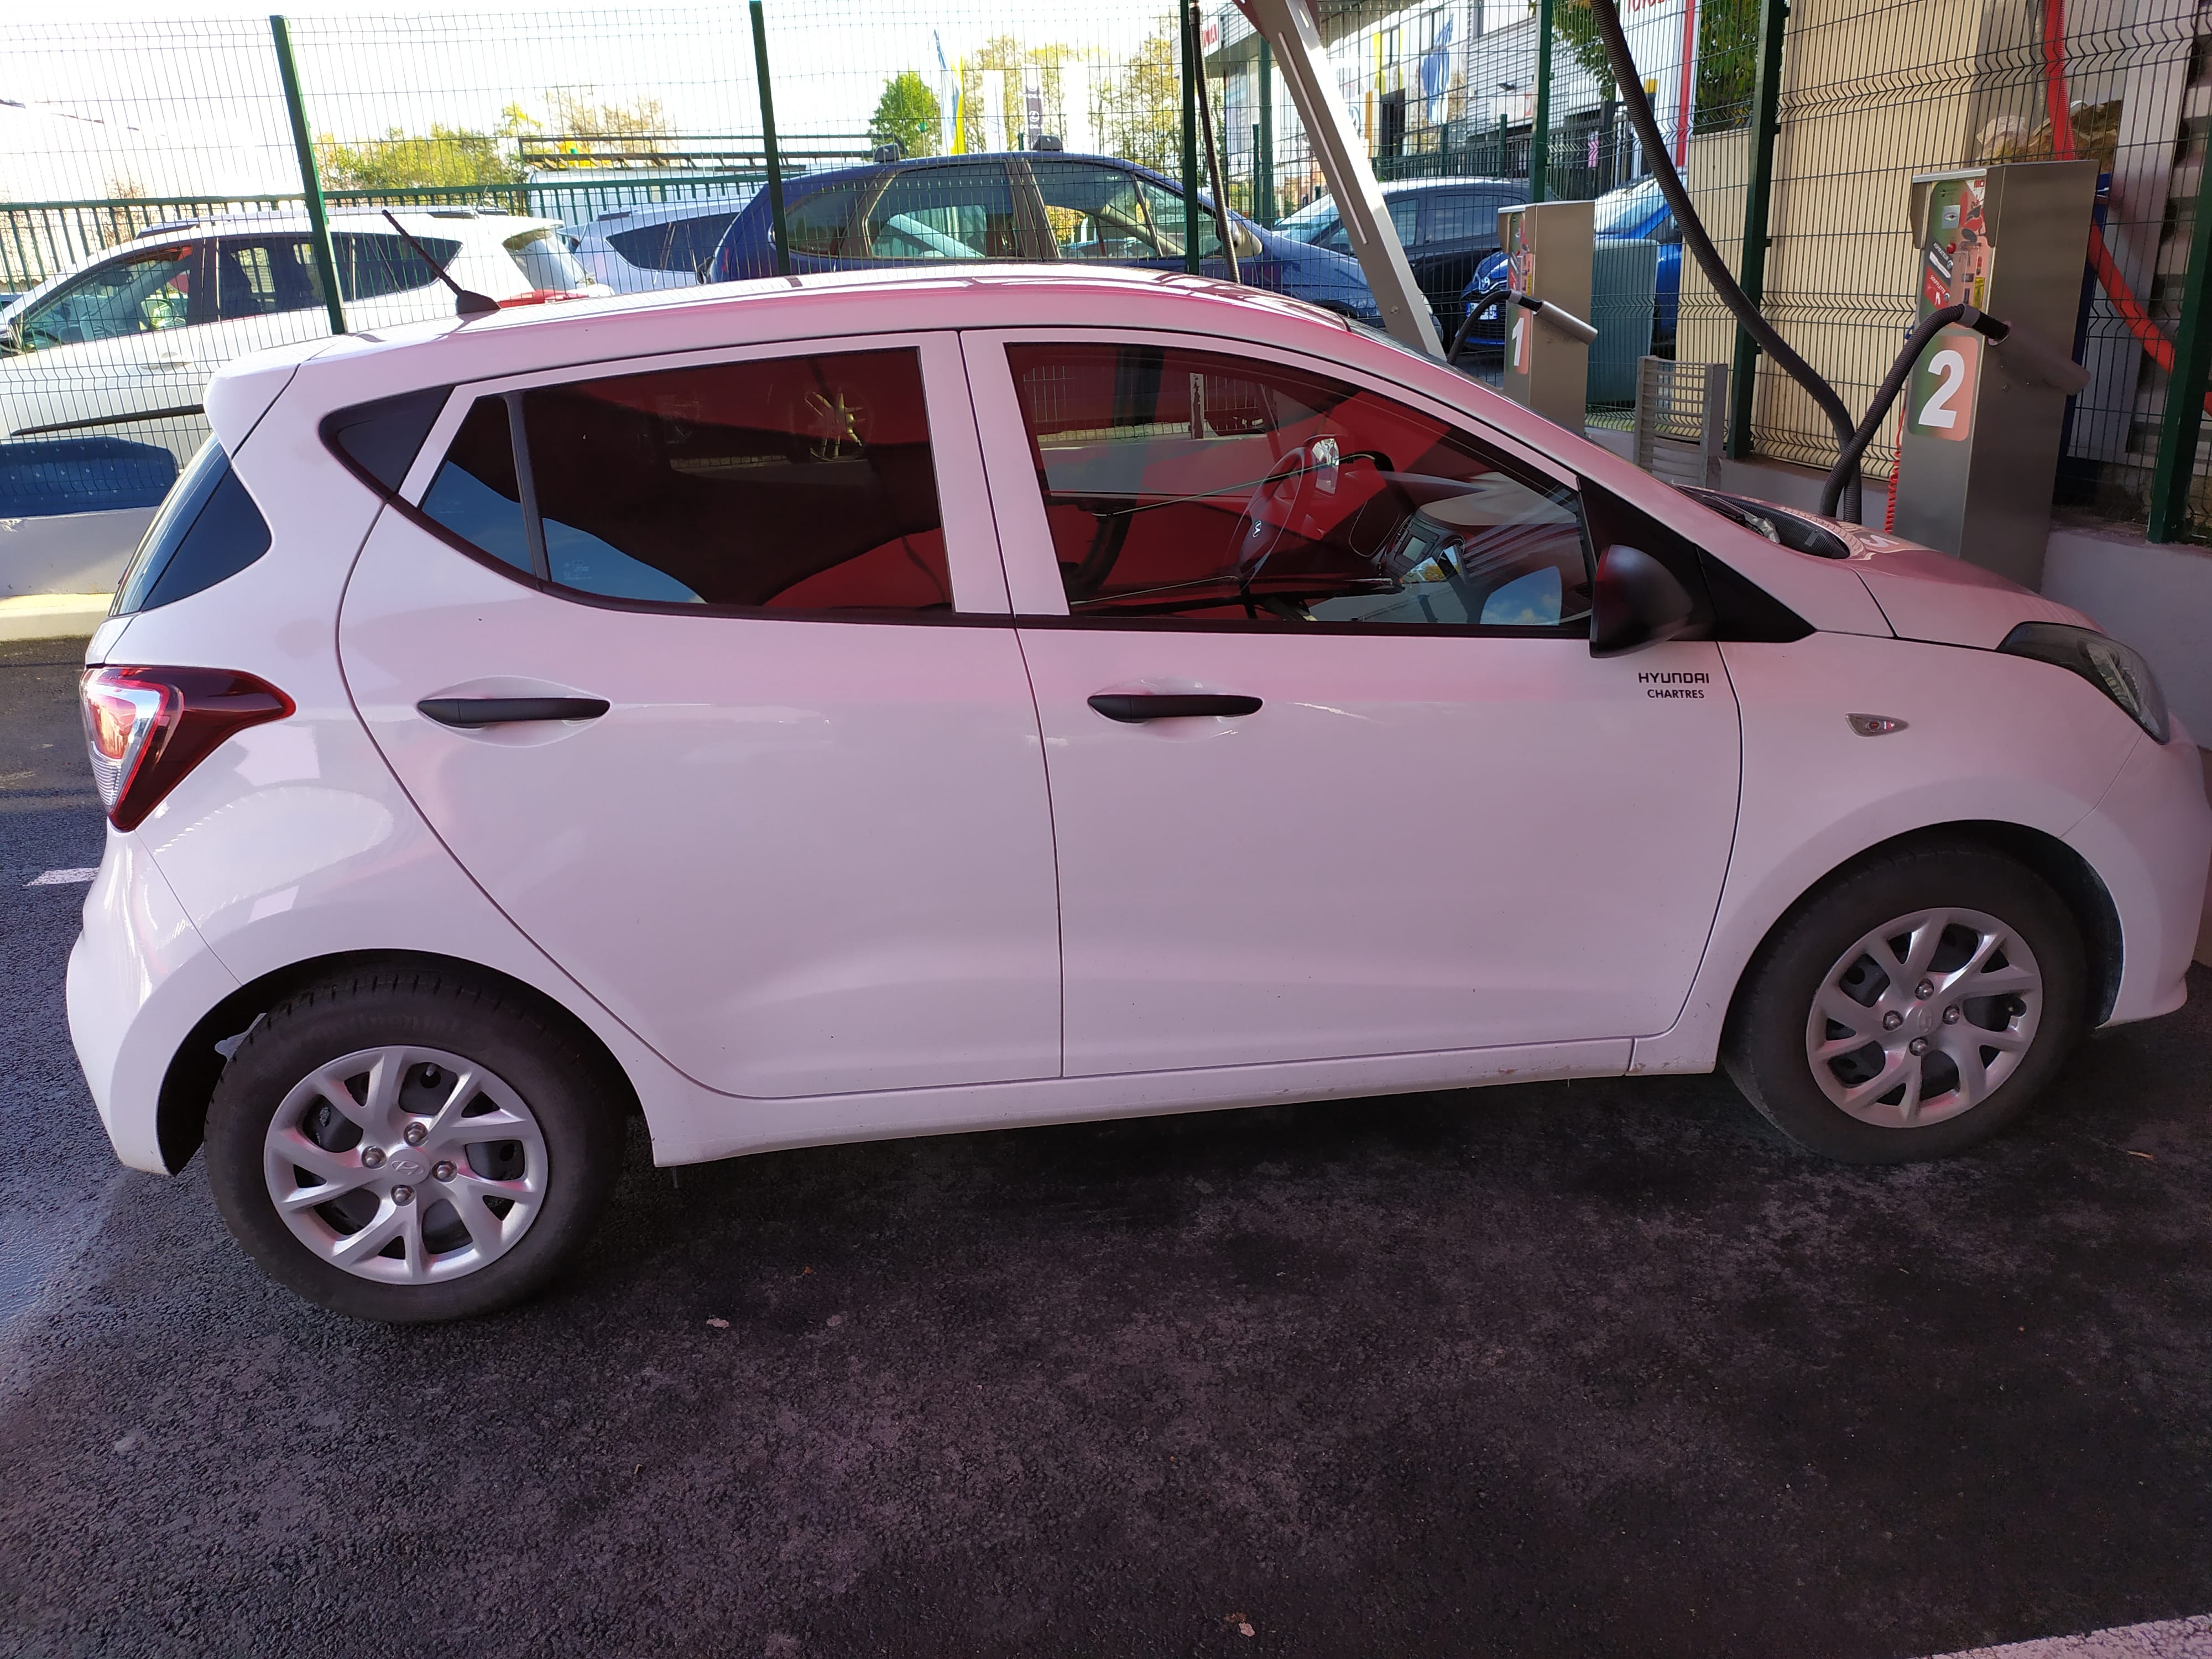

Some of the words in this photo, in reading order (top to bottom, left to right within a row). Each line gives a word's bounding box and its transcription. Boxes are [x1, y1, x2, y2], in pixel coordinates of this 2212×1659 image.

[1512, 317, 1524, 366] 1
[1918, 349, 1965, 428] 2
[1639, 672, 1709, 684] HYUNDAI
[1647, 689, 1704, 698] CHARTRES
